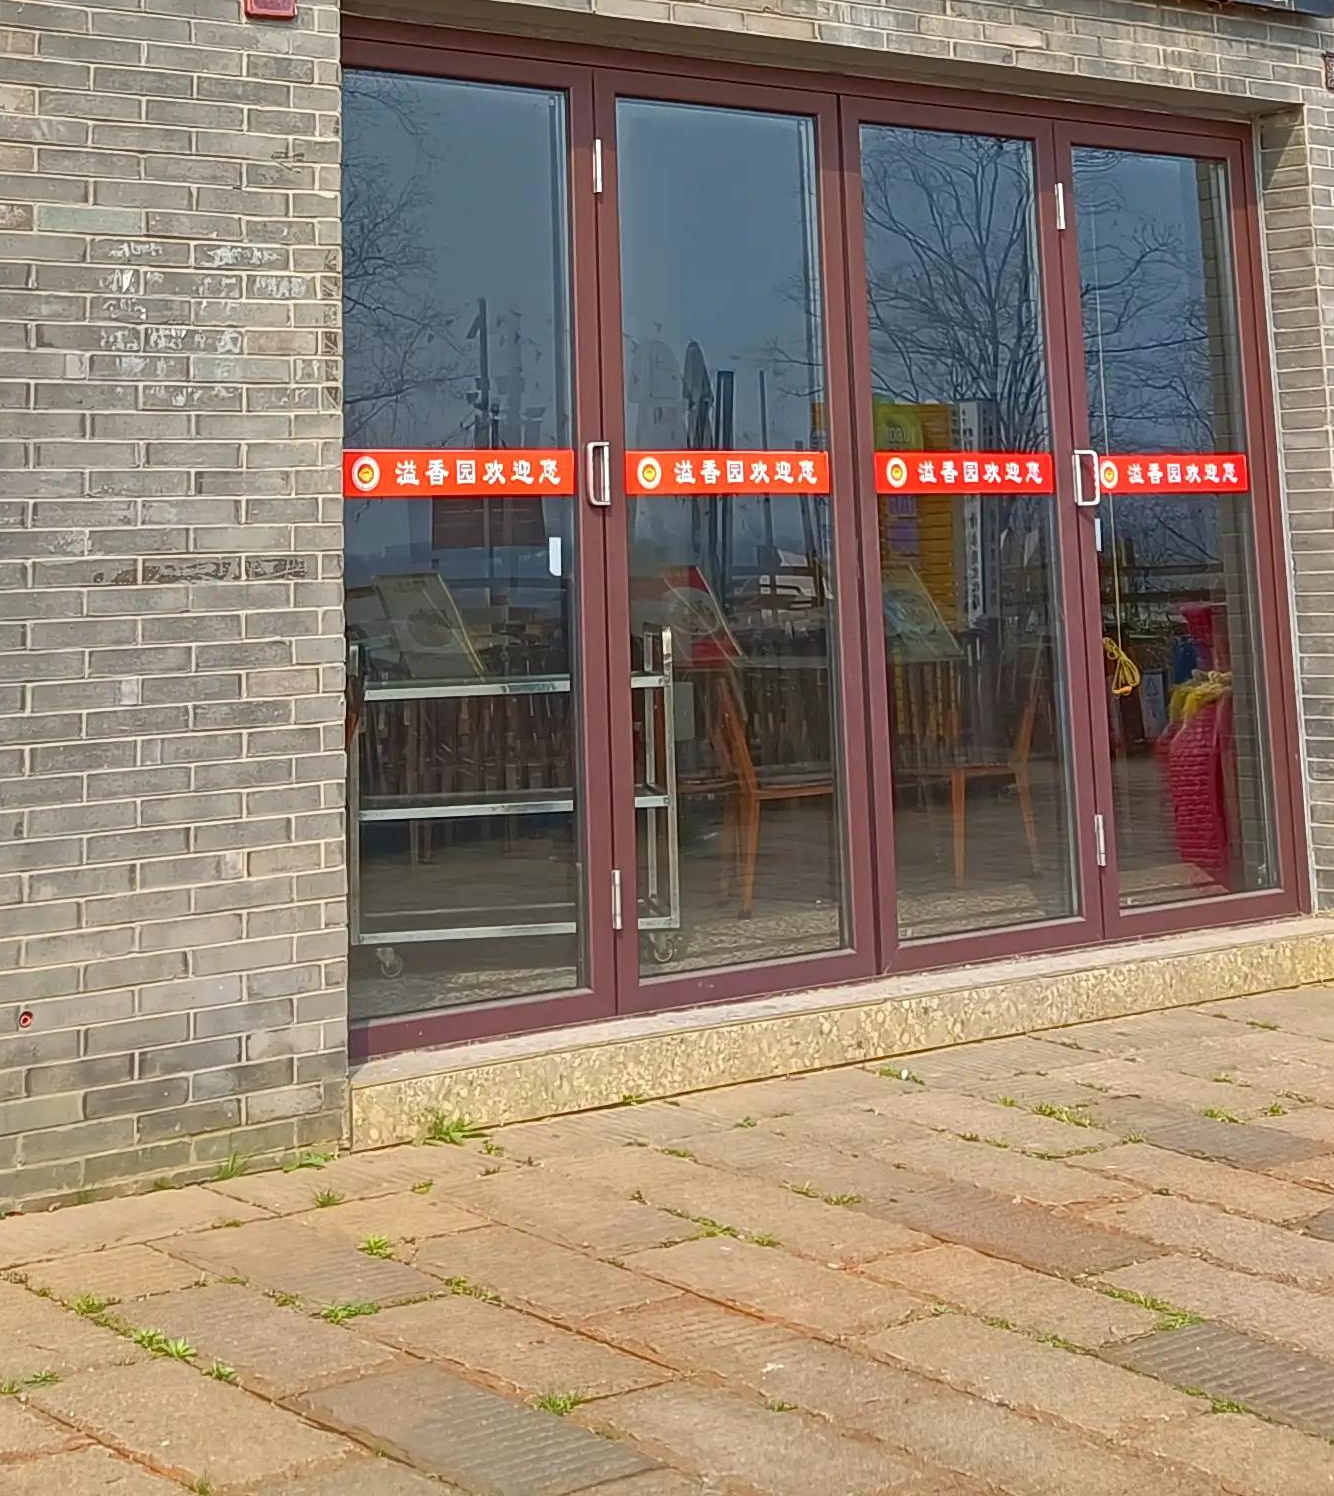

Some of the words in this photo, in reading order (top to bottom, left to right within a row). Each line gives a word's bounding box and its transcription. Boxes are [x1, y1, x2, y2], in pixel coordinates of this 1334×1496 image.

[394, 458, 562, 487] 溢香园欢迎您
[673, 459, 819, 486] 溢香园欢迎您
[917, 460, 1044, 485] 溢香园欢迎您
[1126, 462, 1239, 485] 溢香园欢迎您
